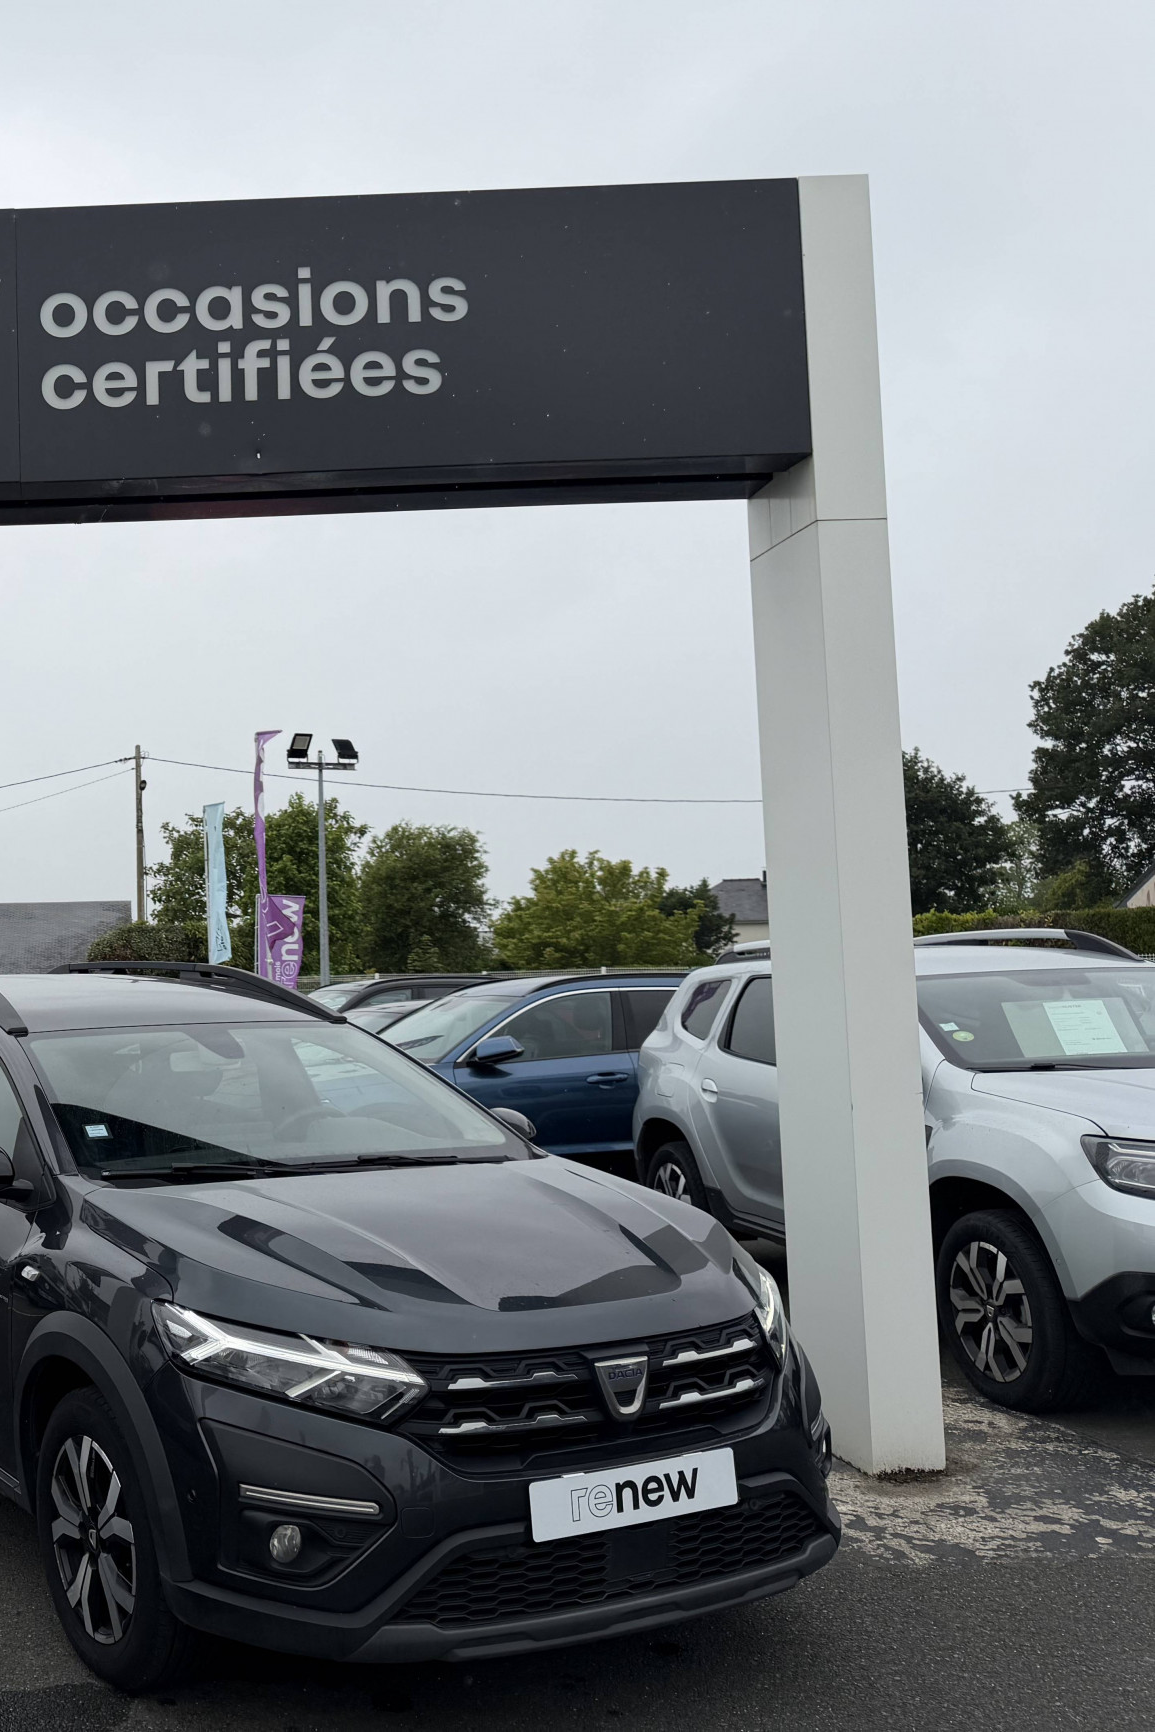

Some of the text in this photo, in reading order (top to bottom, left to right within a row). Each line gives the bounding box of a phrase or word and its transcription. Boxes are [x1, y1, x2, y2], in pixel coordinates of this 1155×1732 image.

[40, 266, 469, 338] occasions
[41, 336, 443, 410] certifiées
[608, 1368, 643, 1380] DACIA
[570, 1467, 699, 1523] renew
